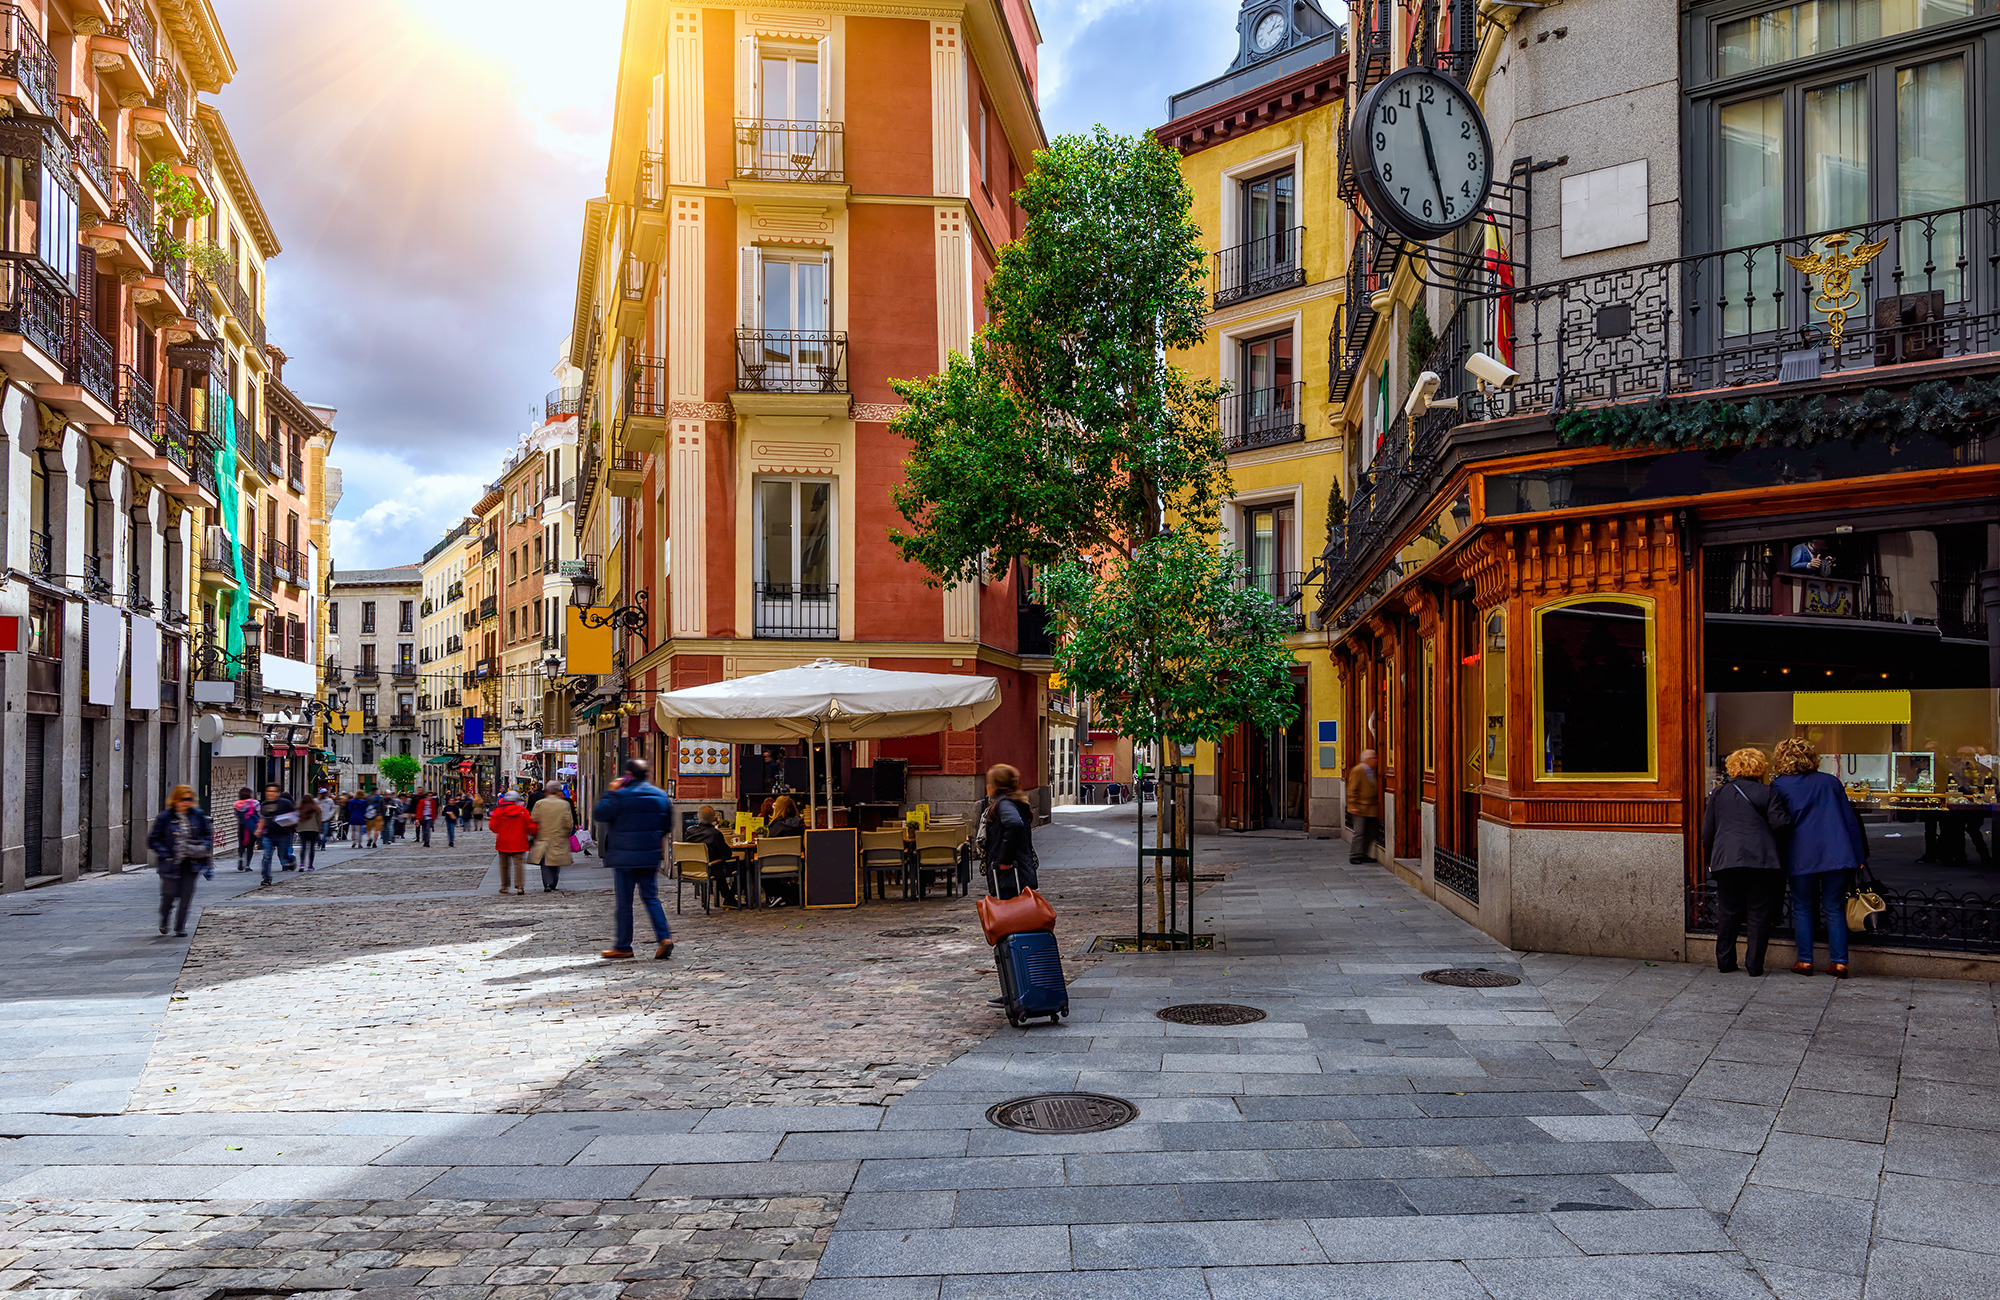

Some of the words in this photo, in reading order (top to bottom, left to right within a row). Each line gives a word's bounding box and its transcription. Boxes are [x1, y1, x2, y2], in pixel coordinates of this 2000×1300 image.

[1398, 88, 1412, 109] 11
[1418, 84, 1435, 104] 12
[1381, 105, 1397, 125] 10
[1446, 98, 1453, 116] 1
[1460, 121, 1471, 140] 2
[1376, 132, 1386, 151] 9
[1467, 152, 1477, 171] 3
[1383, 162, 1392, 182] 8
[1400, 186, 1410, 206] 7
[1460, 180, 1471, 198] 4
[1422, 199, 1432, 218] 6
[1445, 196, 1455, 215] 5
